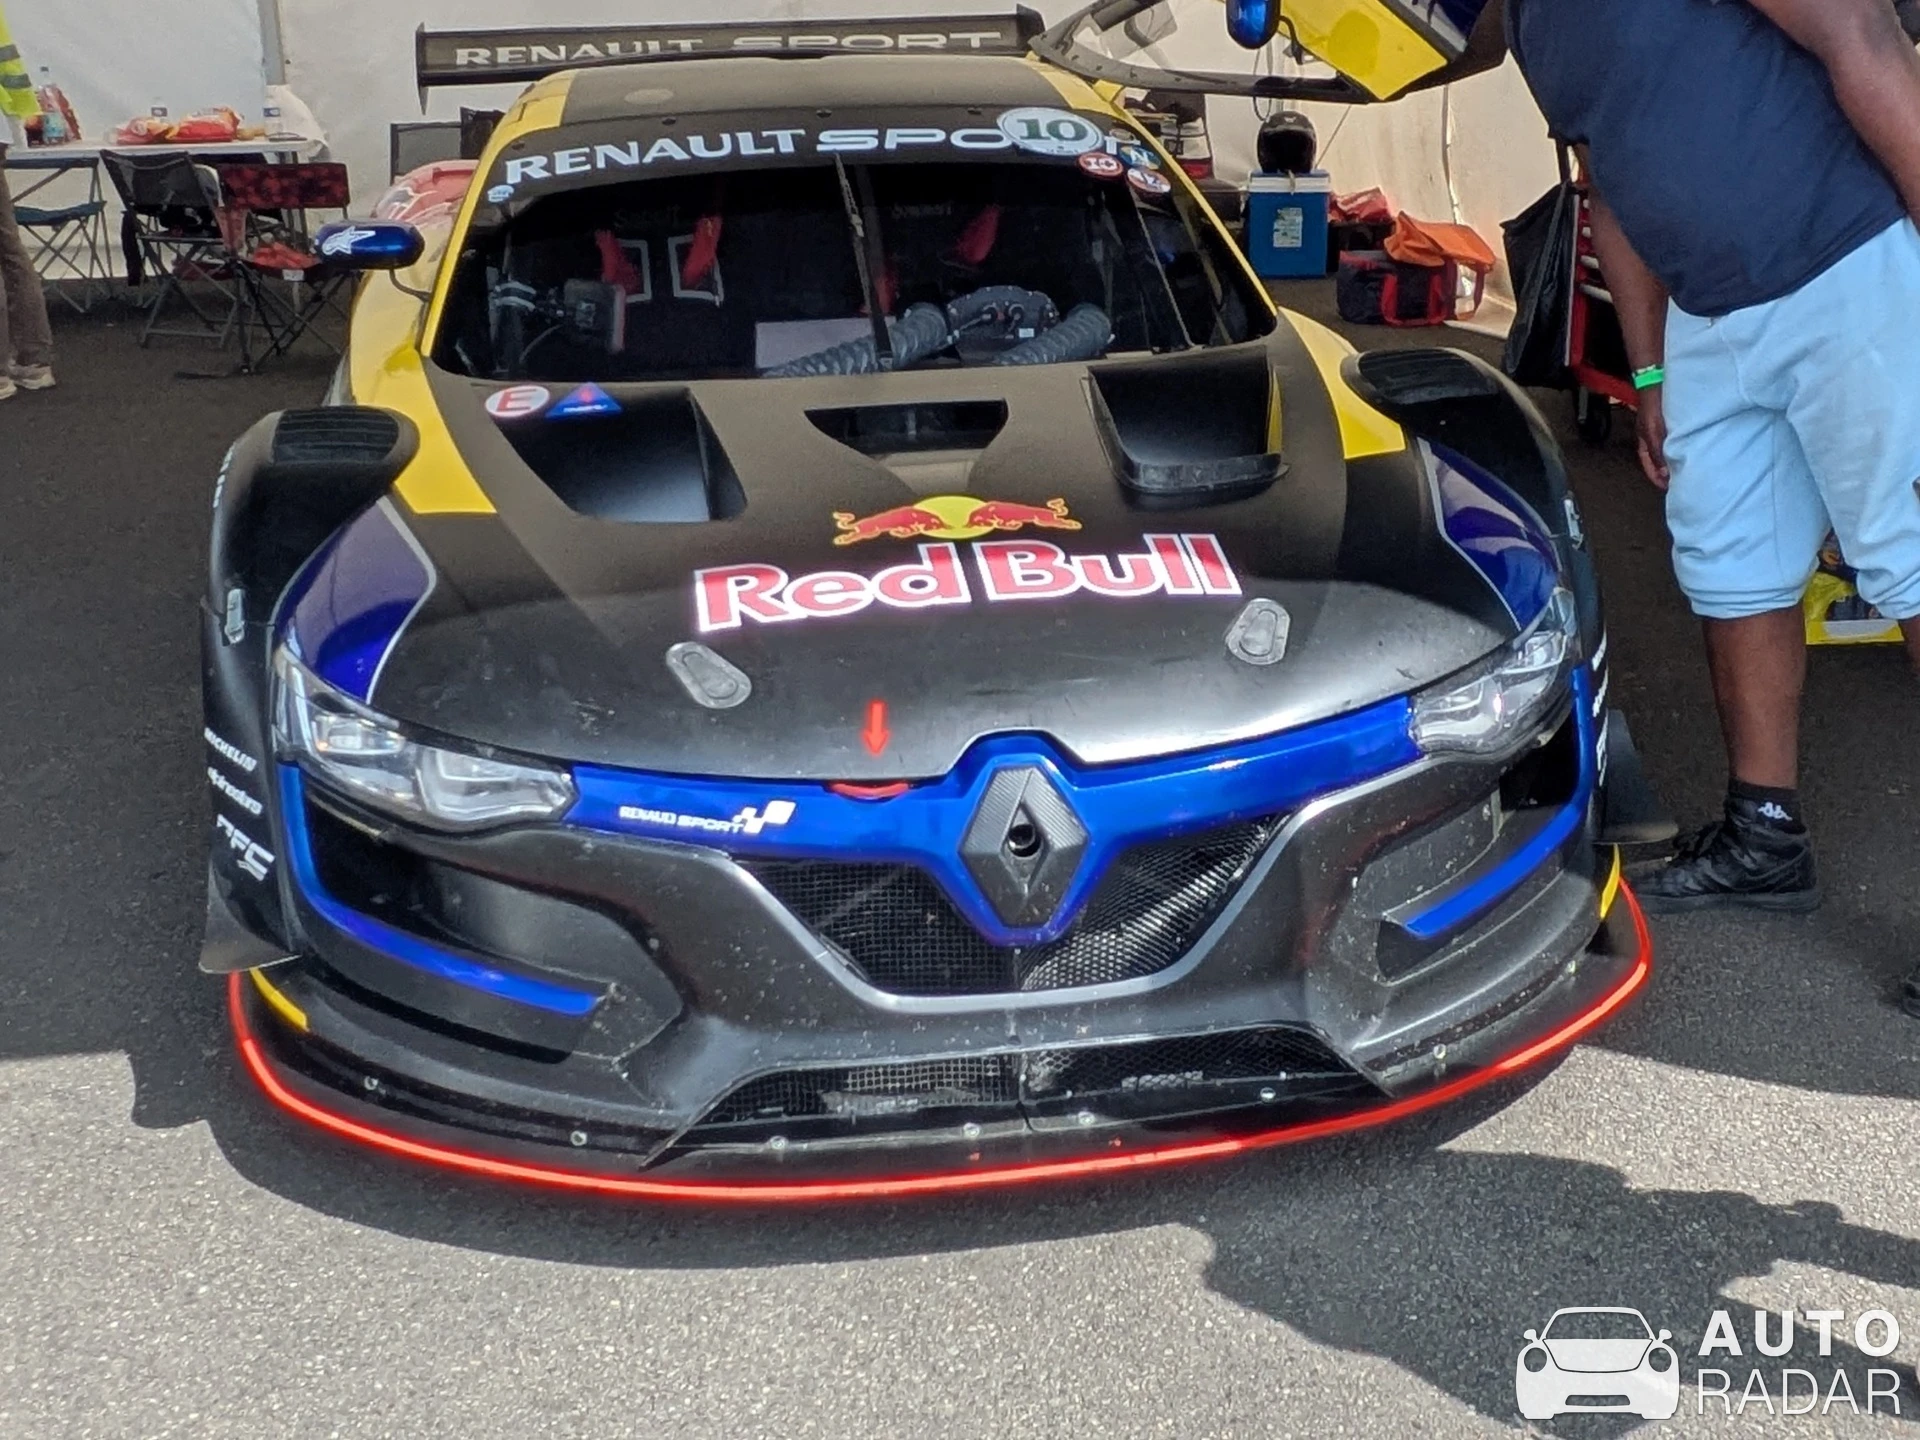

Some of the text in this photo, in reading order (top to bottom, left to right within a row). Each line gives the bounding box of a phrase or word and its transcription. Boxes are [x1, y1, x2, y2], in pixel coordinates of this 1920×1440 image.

[455, 31, 1001, 66] RENAULT SPORT
[1017, 118, 1089, 142] 10
[505, 128, 1141, 185] RENAULT SPOT
[495, 388, 538, 413] E
[694, 532, 1243, 633] Red Bull
